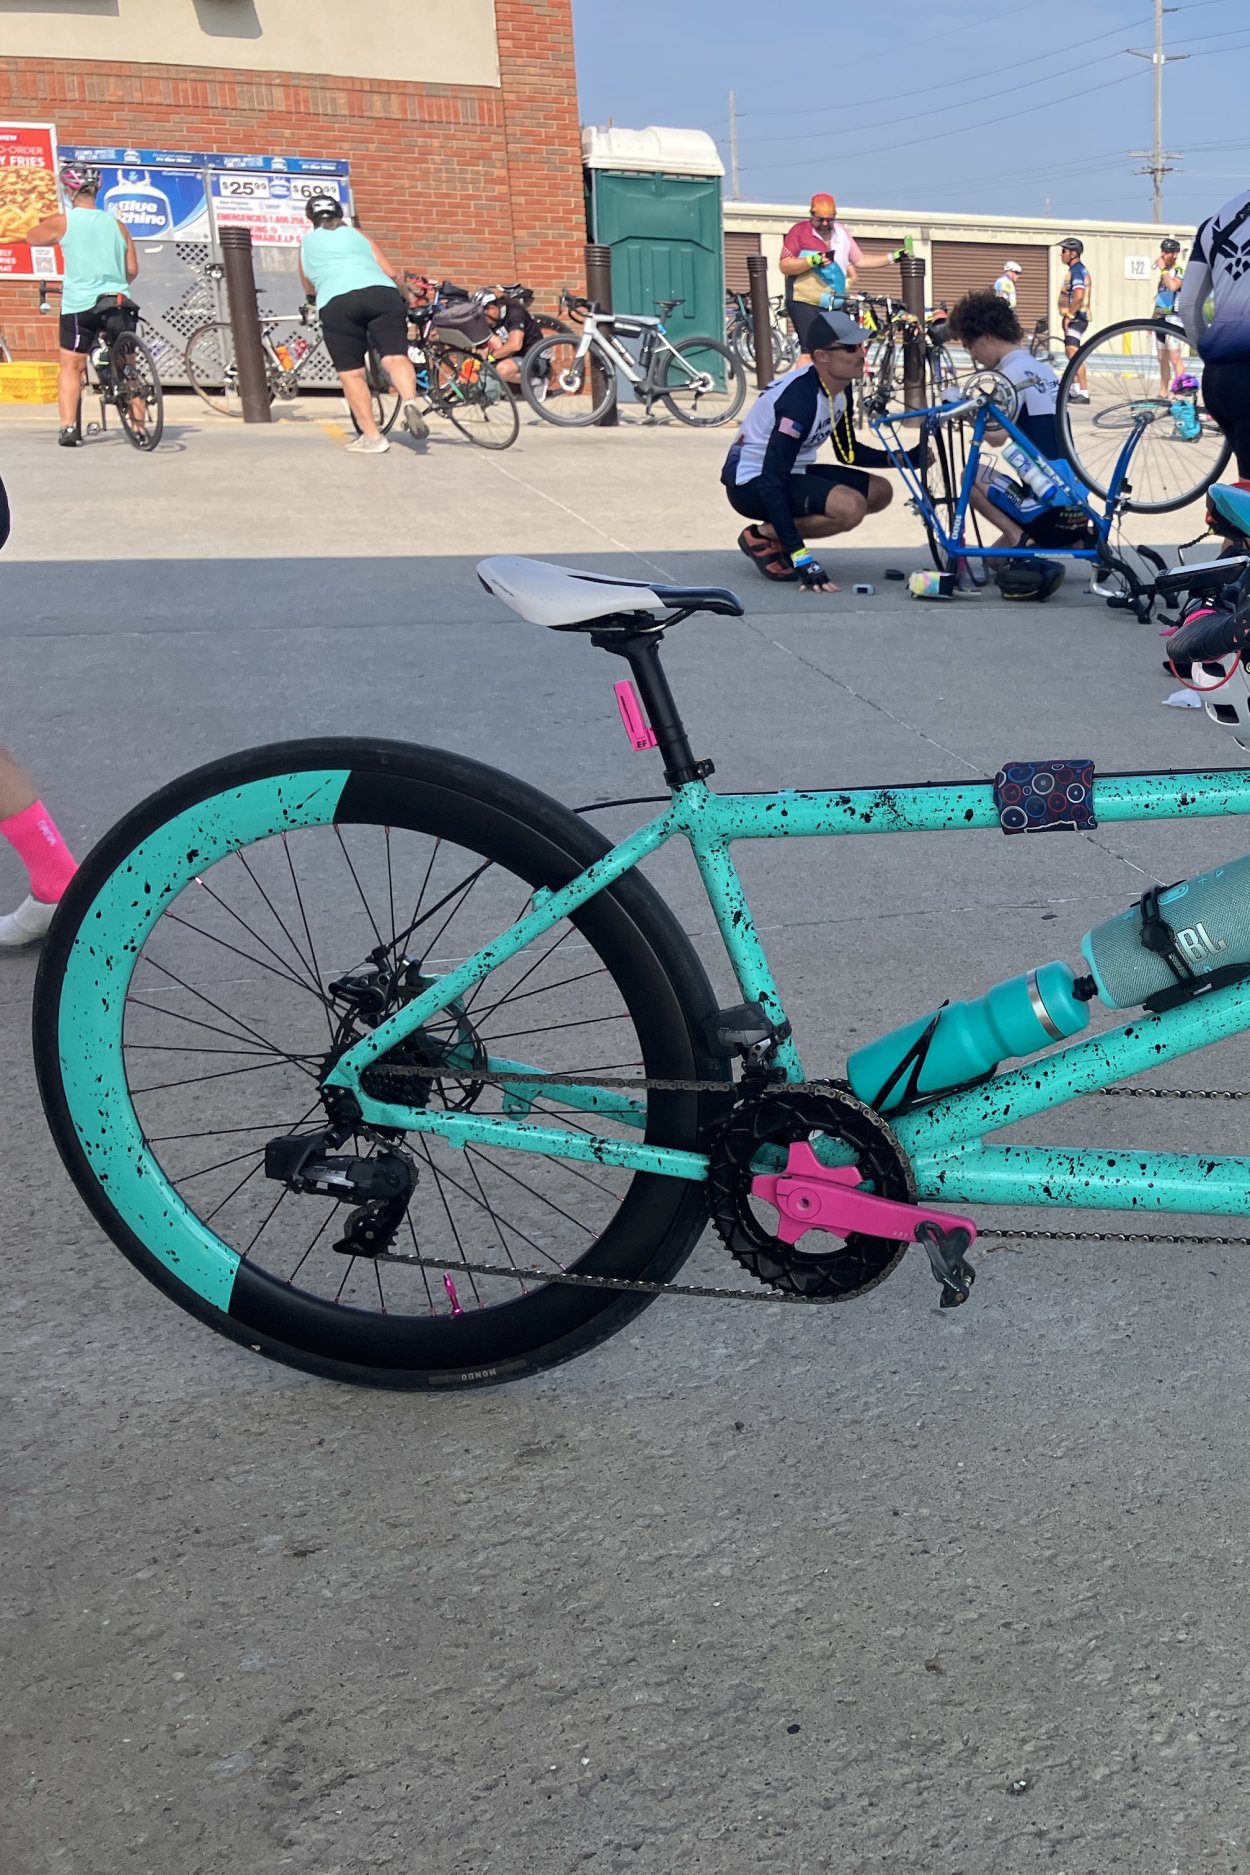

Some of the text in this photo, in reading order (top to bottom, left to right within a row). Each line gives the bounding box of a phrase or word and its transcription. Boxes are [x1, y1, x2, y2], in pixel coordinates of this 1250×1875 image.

[10, 156, 46, 168] FRIES
[118, 200, 158, 213] Blue
[1131, 260, 1145, 275] 1-22
[1174, 921, 1229, 965] BL
[460, 1367, 497, 1381] MONDO
